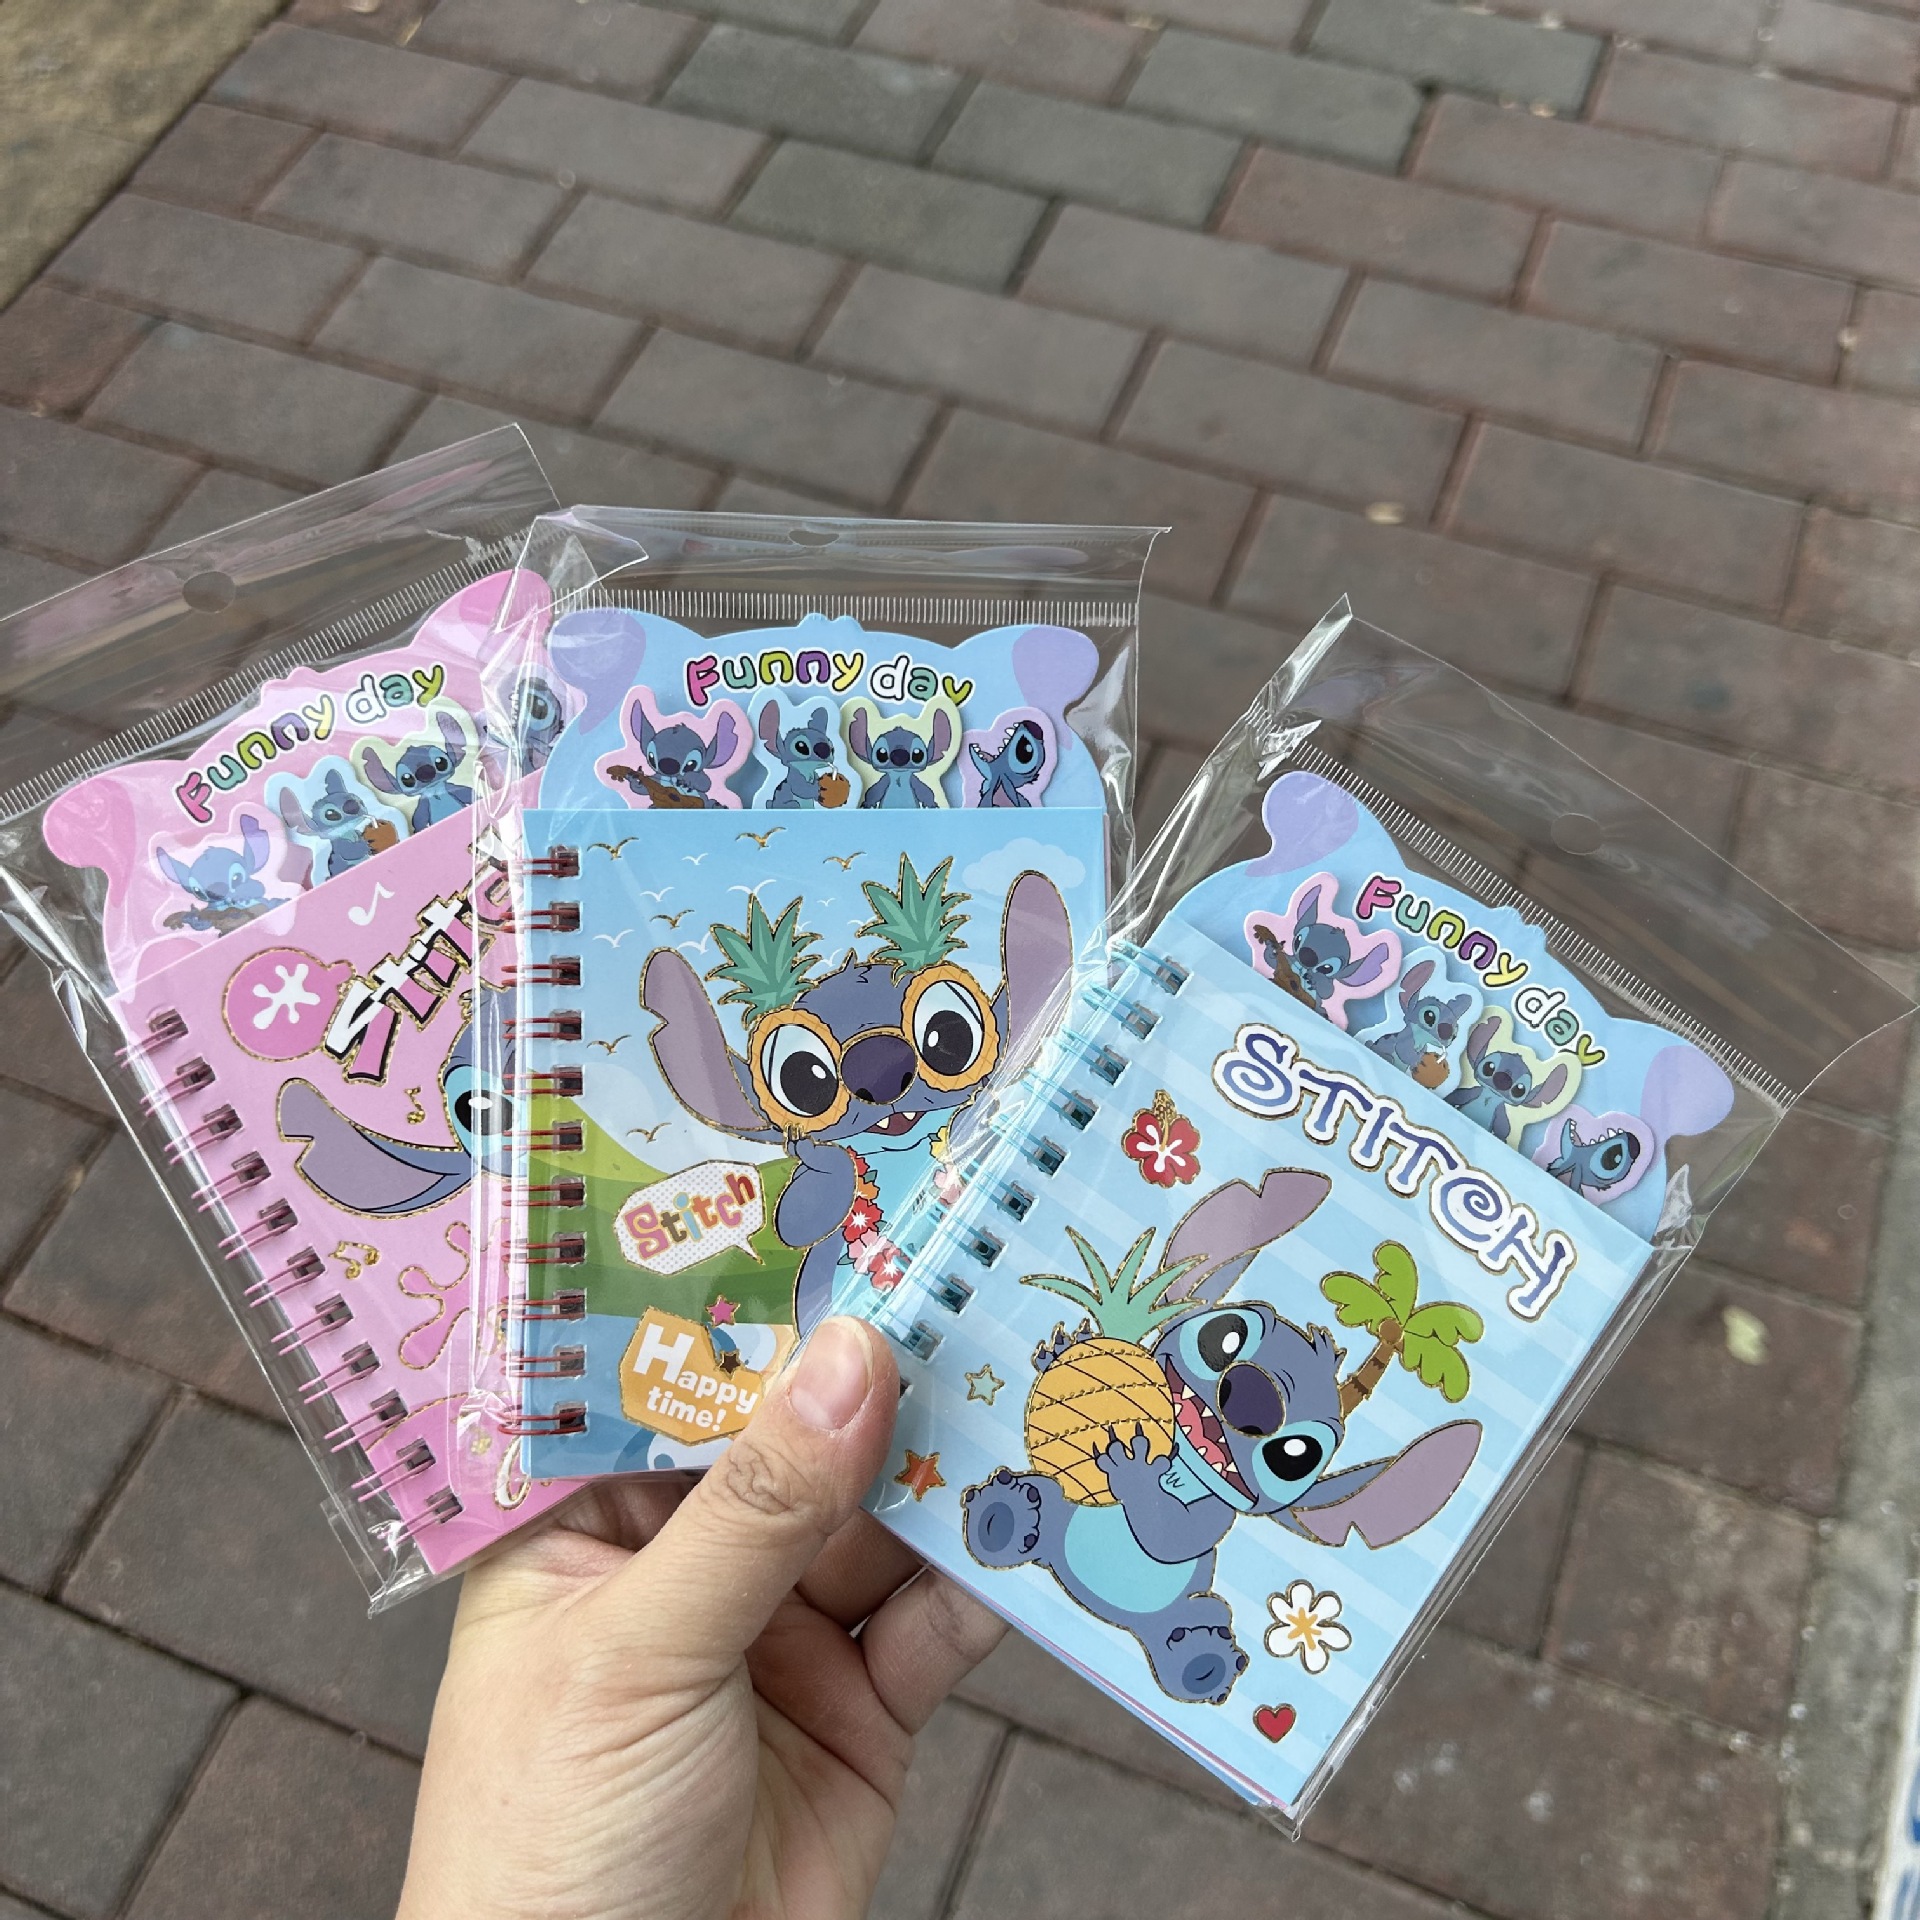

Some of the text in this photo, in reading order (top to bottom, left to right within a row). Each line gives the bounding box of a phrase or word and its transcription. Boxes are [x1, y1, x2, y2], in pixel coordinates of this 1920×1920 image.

[685, 649, 864, 706] Funny
[175, 664, 445, 824] Funny day
[1354, 874, 1607, 1067] Funny day
[623, 1171, 757, 1261] Stitch
[1216, 1026, 1573, 1318] STITCH
[632, 1322, 760, 1415] Happy
[645, 1385, 728, 1433] time!
